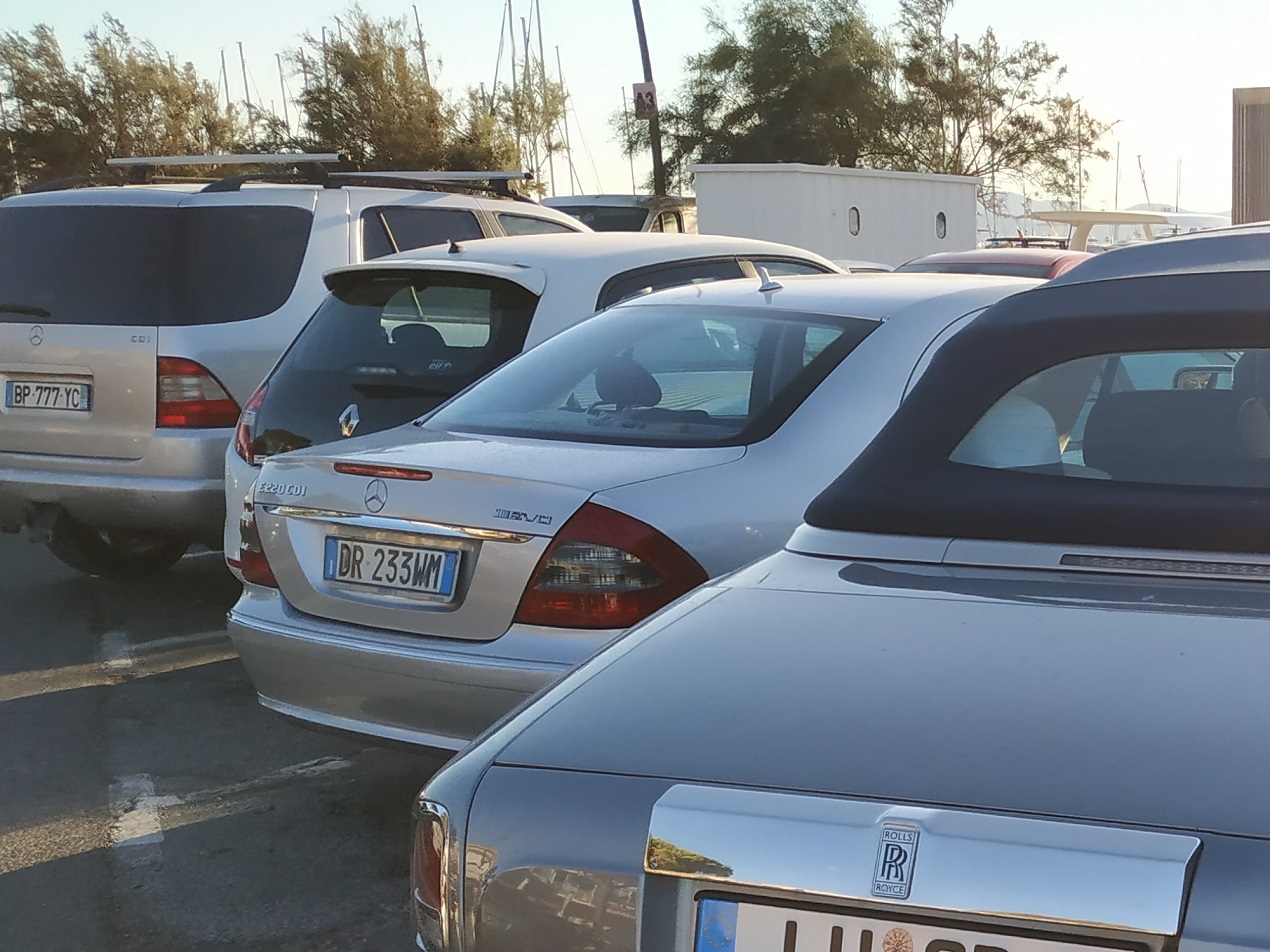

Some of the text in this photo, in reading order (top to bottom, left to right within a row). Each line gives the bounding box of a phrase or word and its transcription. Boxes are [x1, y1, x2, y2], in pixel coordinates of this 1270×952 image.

[131, 335, 151, 343] CDI
[259, 482, 307, 497] E220 CDI
[338, 543, 443, 589] DR 233WM
[884, 830, 913, 842] ROLLS
[875, 883, 904, 894] ROYCE
